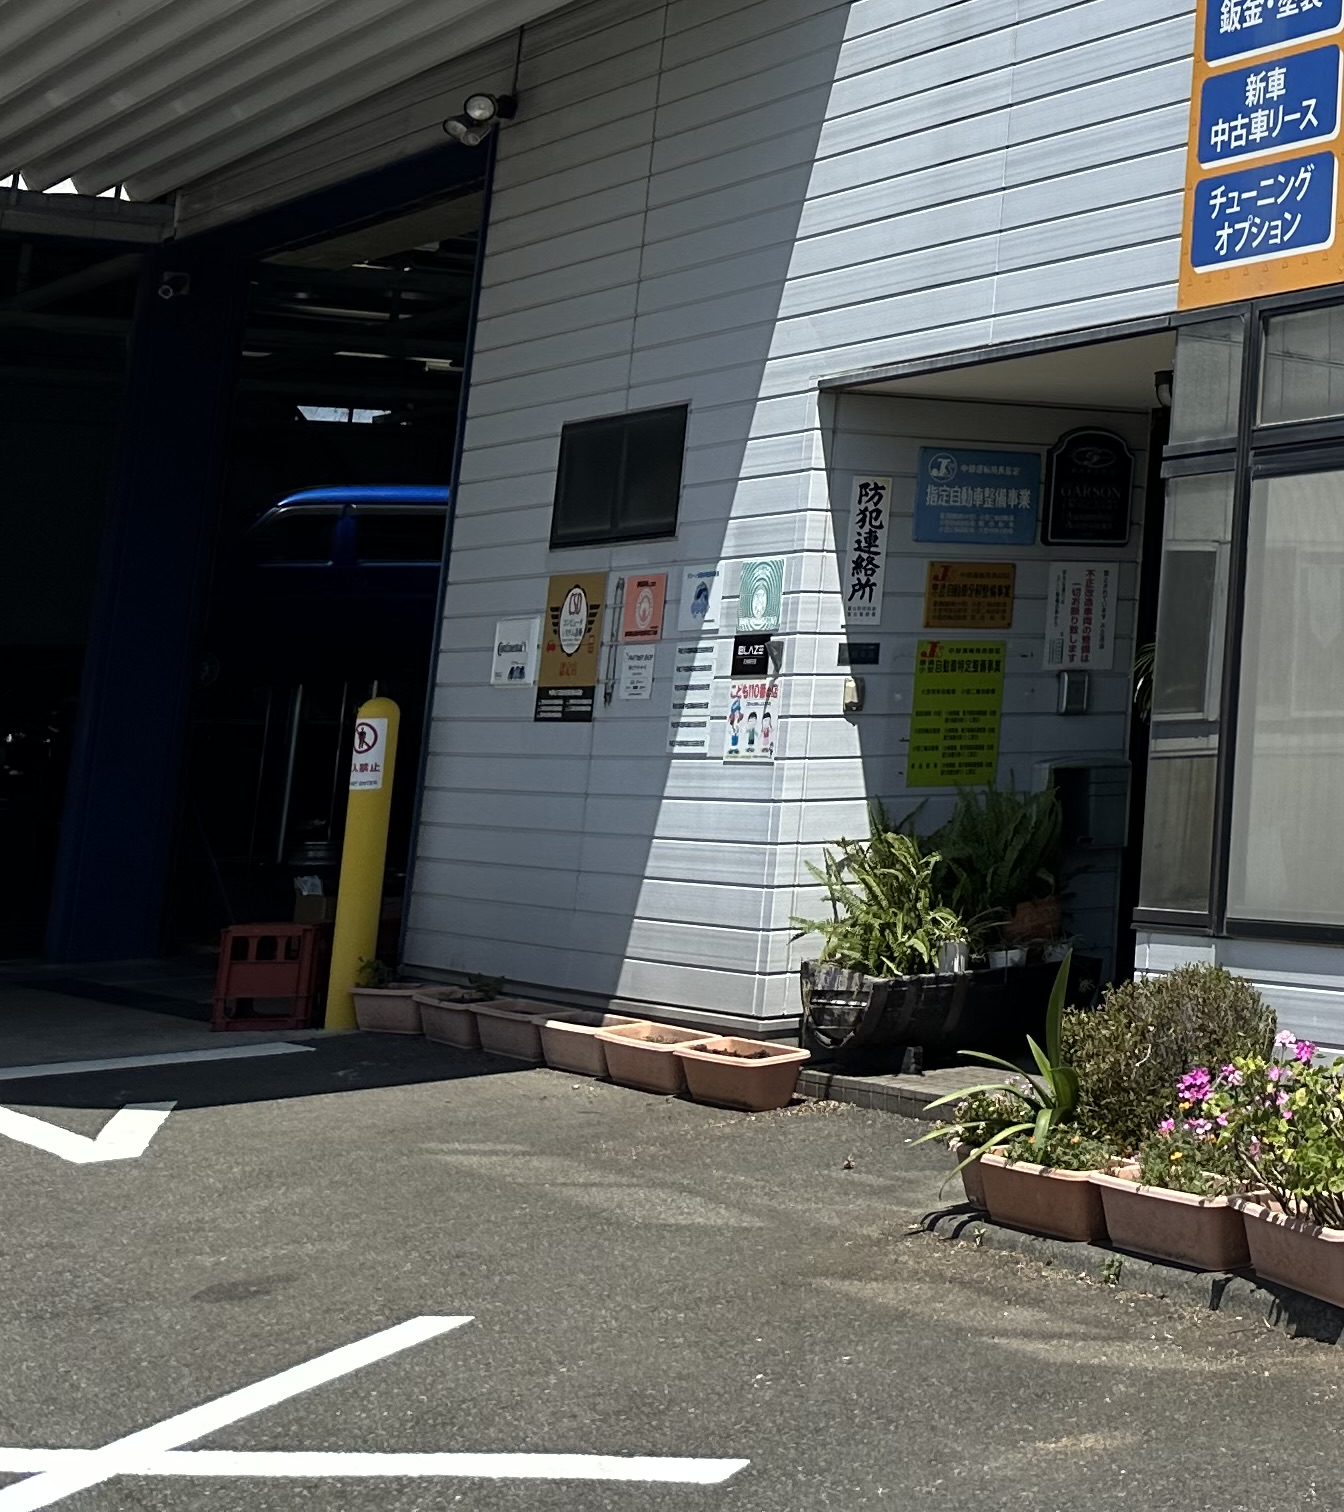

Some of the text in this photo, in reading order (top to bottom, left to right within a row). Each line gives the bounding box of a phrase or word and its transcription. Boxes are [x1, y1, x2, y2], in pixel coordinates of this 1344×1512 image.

[1244, 69, 1287, 106] 新車
[1210, 98, 1319, 148] 中古車リース
[1209, 164, 1315, 219] チューニング
[1213, 210, 1302, 246] オプション
[926, 484, 1031, 509] 指定自動車整備事業
[847, 481, 886, 603] 防犯連絡所
